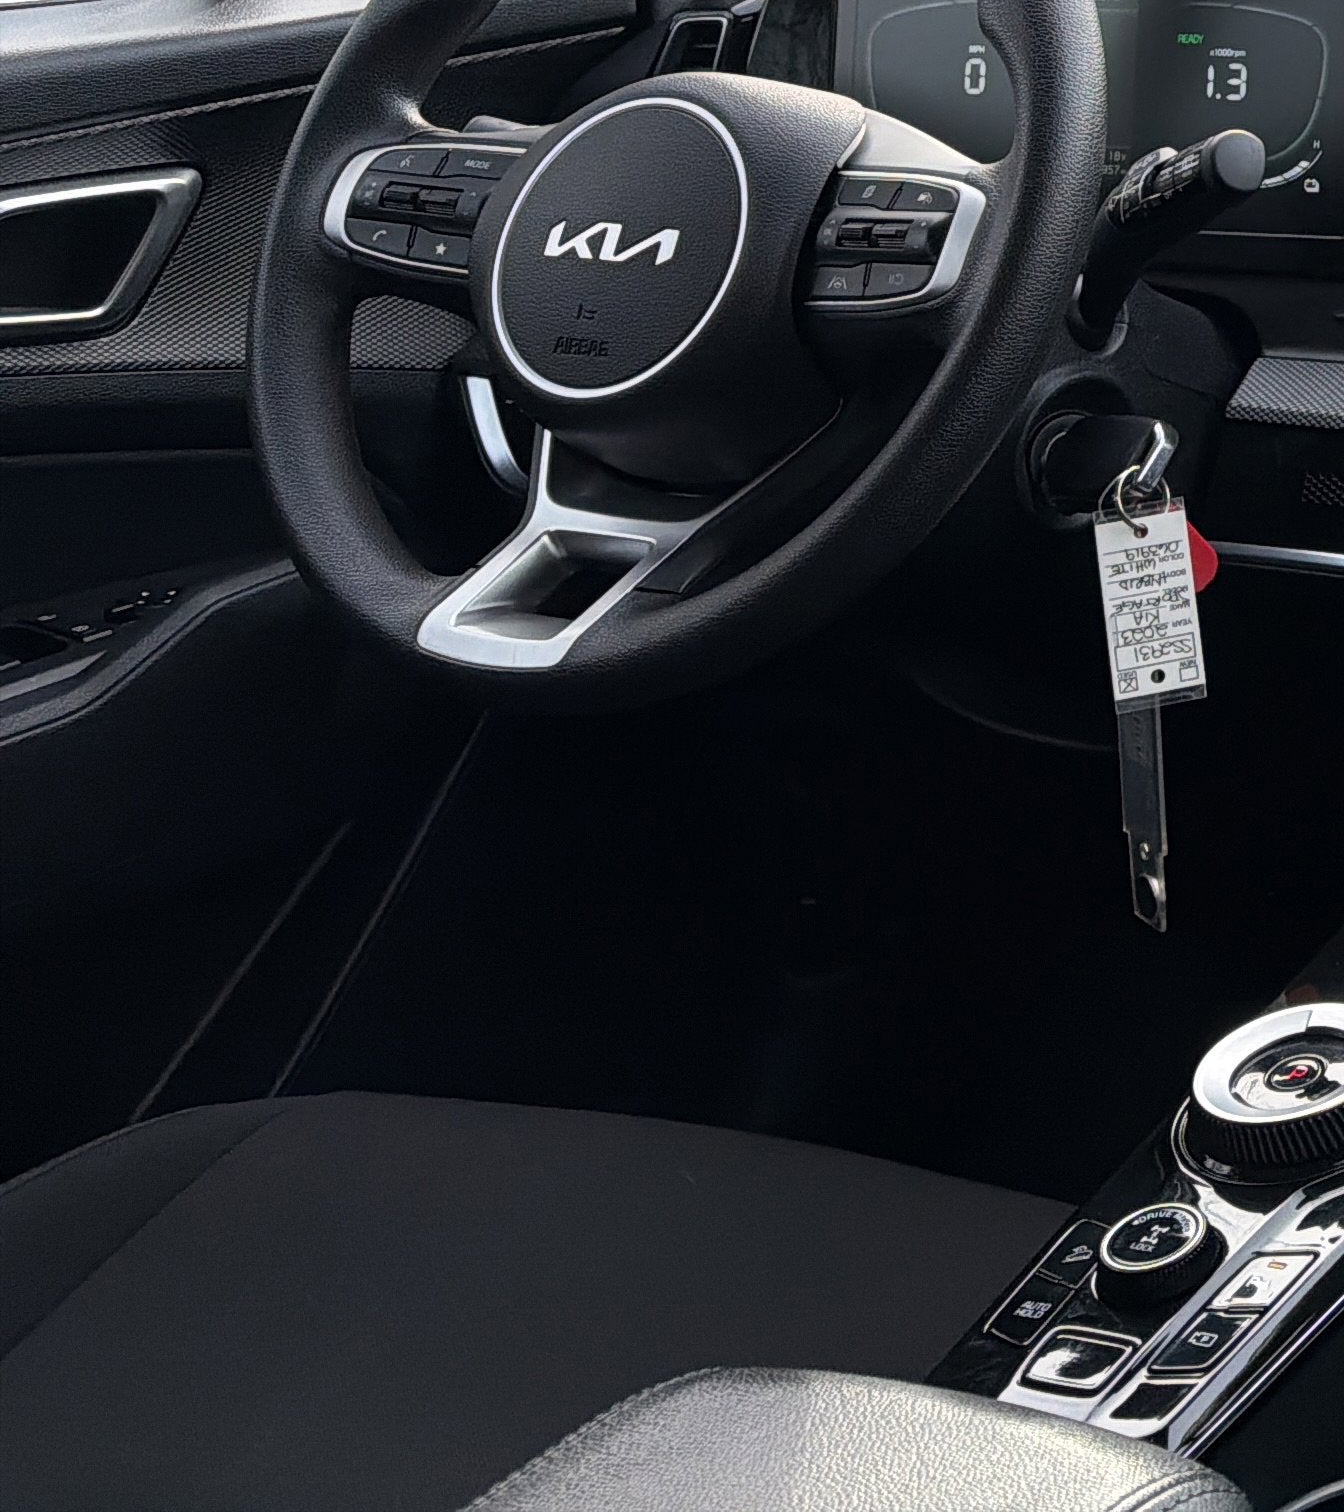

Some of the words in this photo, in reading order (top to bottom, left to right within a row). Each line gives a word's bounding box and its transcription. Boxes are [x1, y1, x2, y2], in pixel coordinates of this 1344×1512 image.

[1177, 34, 1204, 44] READY
[964, 57, 987, 94] 0
[1206, 62, 1248, 101] 1.3
[464, 159, 492, 170] MODE
[542, 219, 681, 266] KIA
[1158, 552, 1185, 563] COLOR
[1110, 559, 1157, 577] WHITE
[1169, 601, 1191, 611] MAKE
[1133, 609, 1160, 625] KIA
[1171, 617, 1193, 627] YEAR
[1120, 624, 1169, 644] 2023
[1130, 1242, 1156, 1253] LOCK
[1021, 1300, 1052, 1312] AUTO
[1013, 1308, 1047, 1319] HOLD
